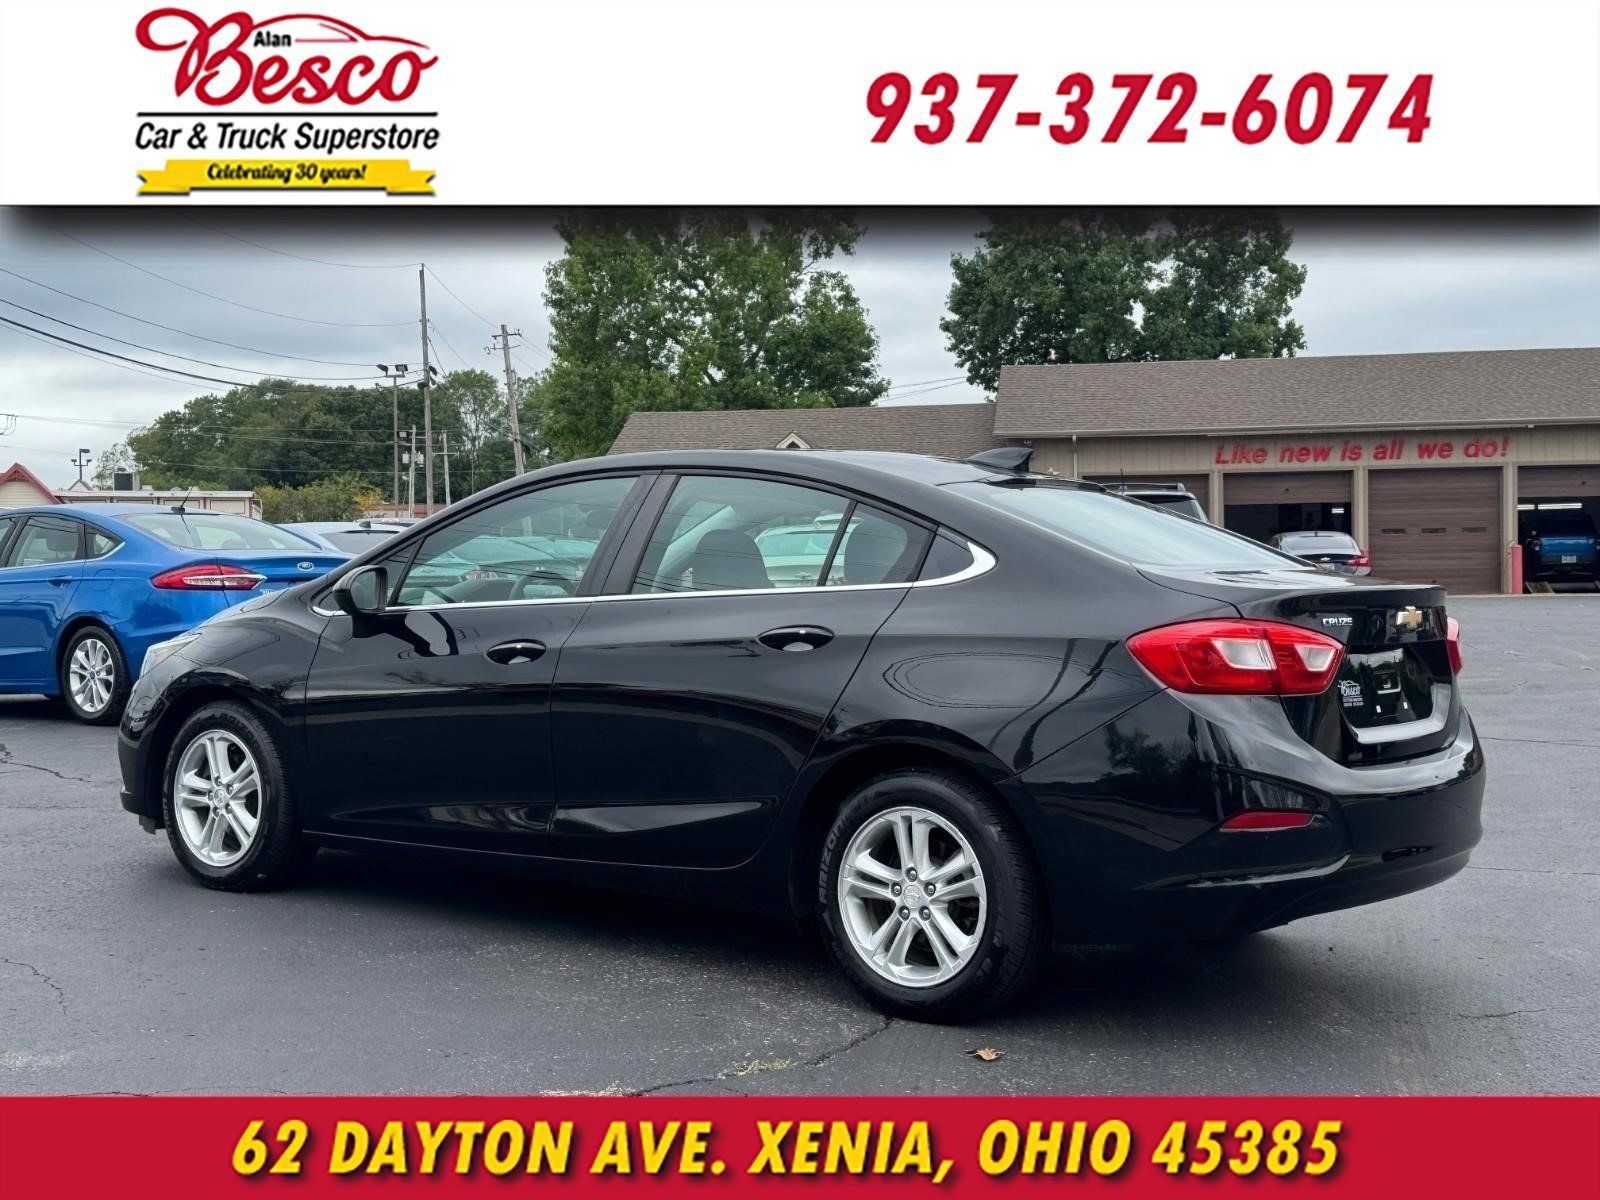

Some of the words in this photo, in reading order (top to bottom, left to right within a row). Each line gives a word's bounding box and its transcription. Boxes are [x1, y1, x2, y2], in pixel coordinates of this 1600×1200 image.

[1215, 443, 1269, 465] Like
[1279, 445, 1332, 463] new
[1340, 441, 1363, 462] is
[1372, 440, 1404, 462] all
[1416, 442, 1454, 460] we
[1463, 437, 1510, 458] do!
